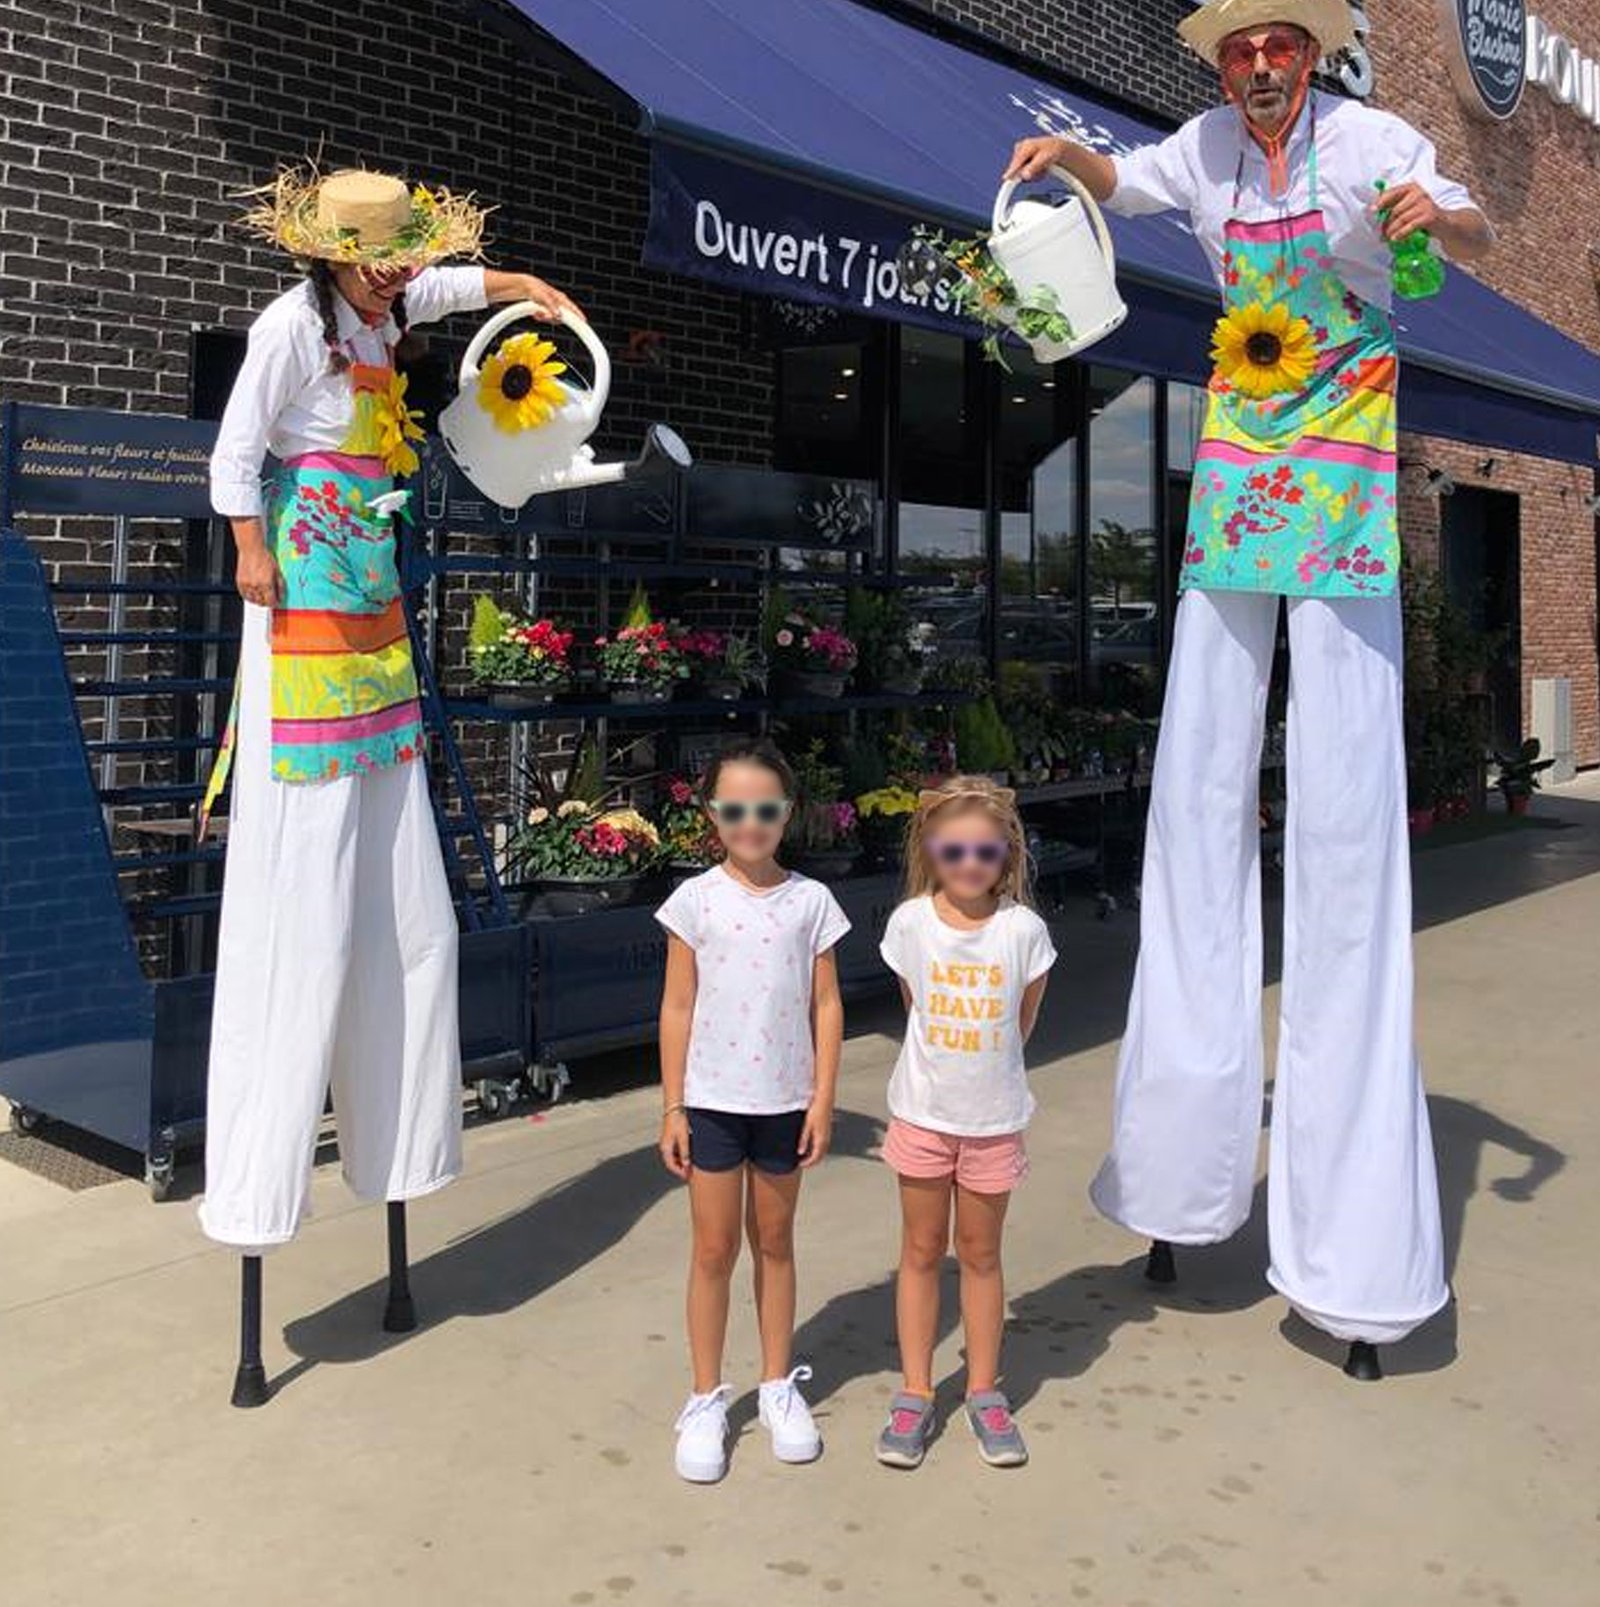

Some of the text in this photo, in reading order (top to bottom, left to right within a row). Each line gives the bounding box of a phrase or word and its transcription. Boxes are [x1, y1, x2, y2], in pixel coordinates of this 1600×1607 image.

[1525, 13, 1600, 126] BOU
[694, 200, 829, 284] Ouvert
[838, 237, 860, 289] 7
[110, 442, 149, 464] fleurs
[152, 448, 165, 461] et
[20, 462, 83, 477] Monceau
[927, 961, 1003, 988] LET'S
[929, 993, 1004, 1020] HAVE
[927, 1024, 981, 1053] FUN
